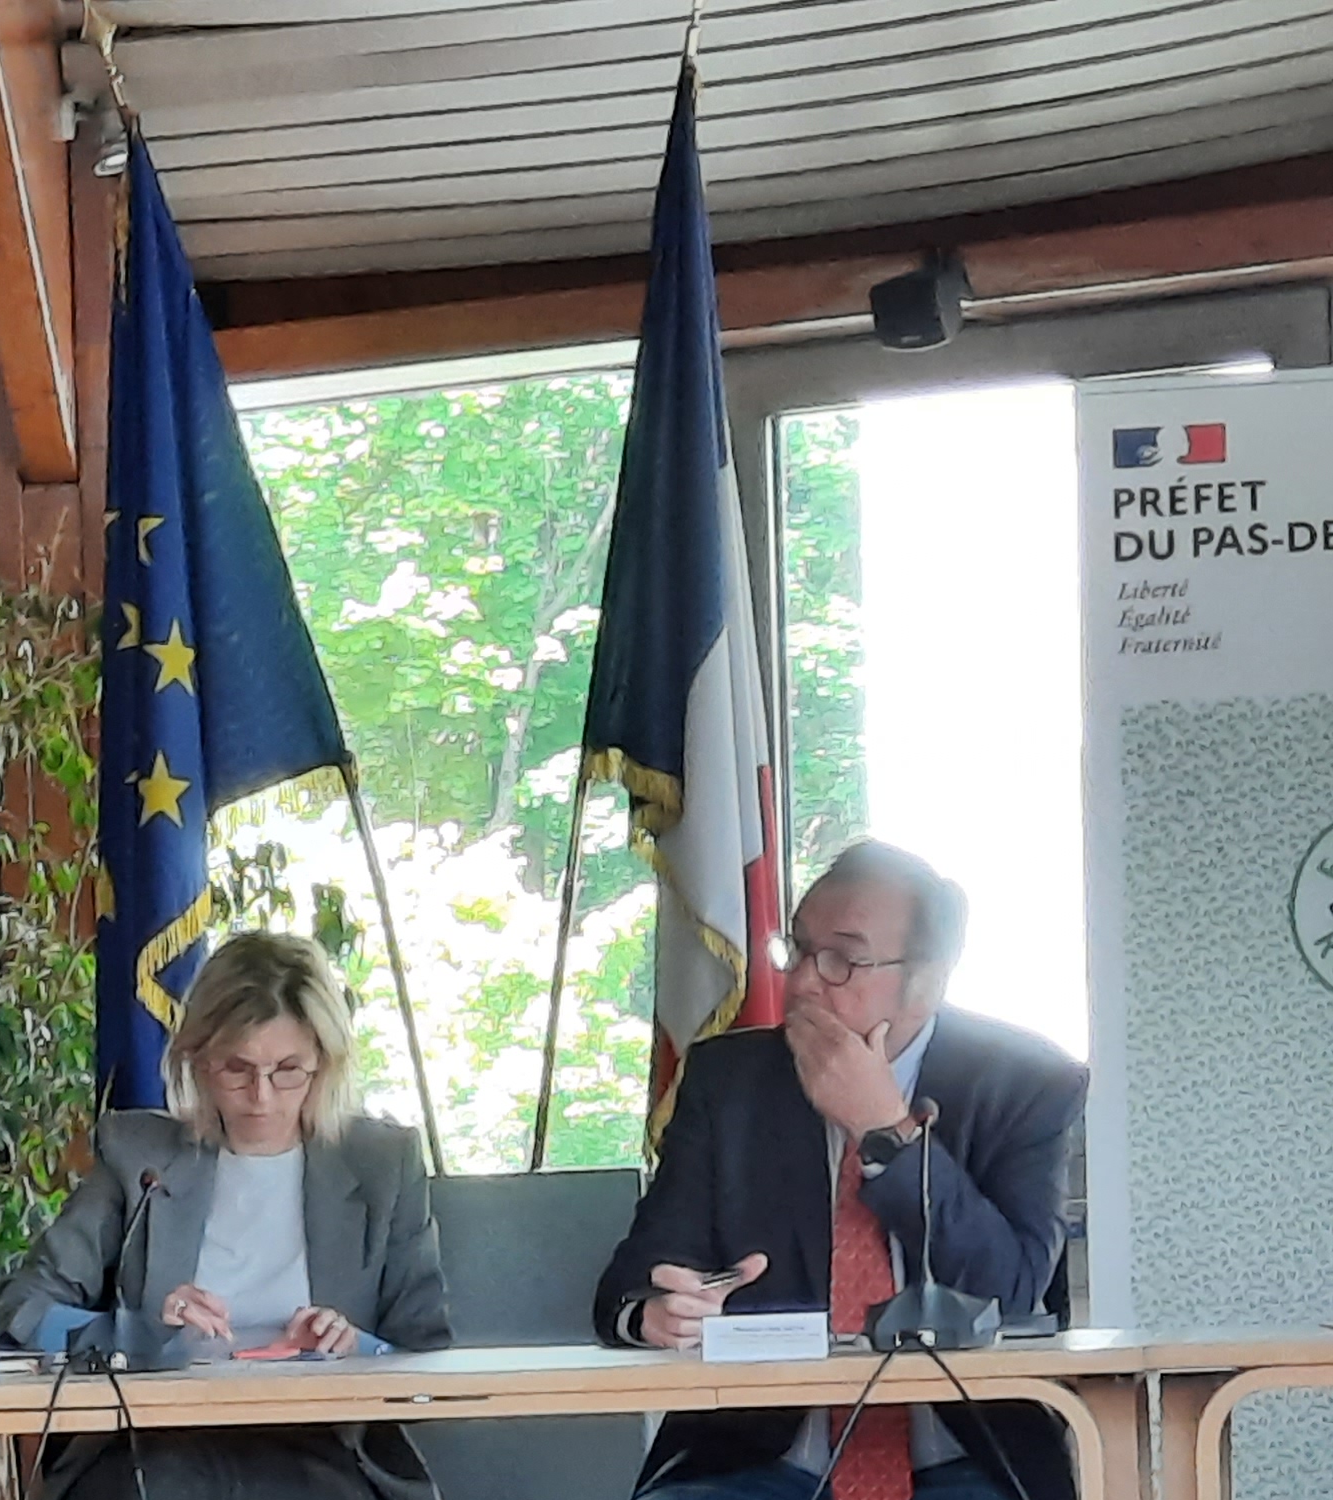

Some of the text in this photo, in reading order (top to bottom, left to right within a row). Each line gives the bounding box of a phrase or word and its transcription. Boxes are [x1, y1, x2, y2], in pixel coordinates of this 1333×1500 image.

[1113, 476, 1267, 519] PRÉFET
[1114, 529, 1175, 563] DU
[1117, 578, 1190, 601] Liberté
[1118, 631, 1223, 655] Fraternité
